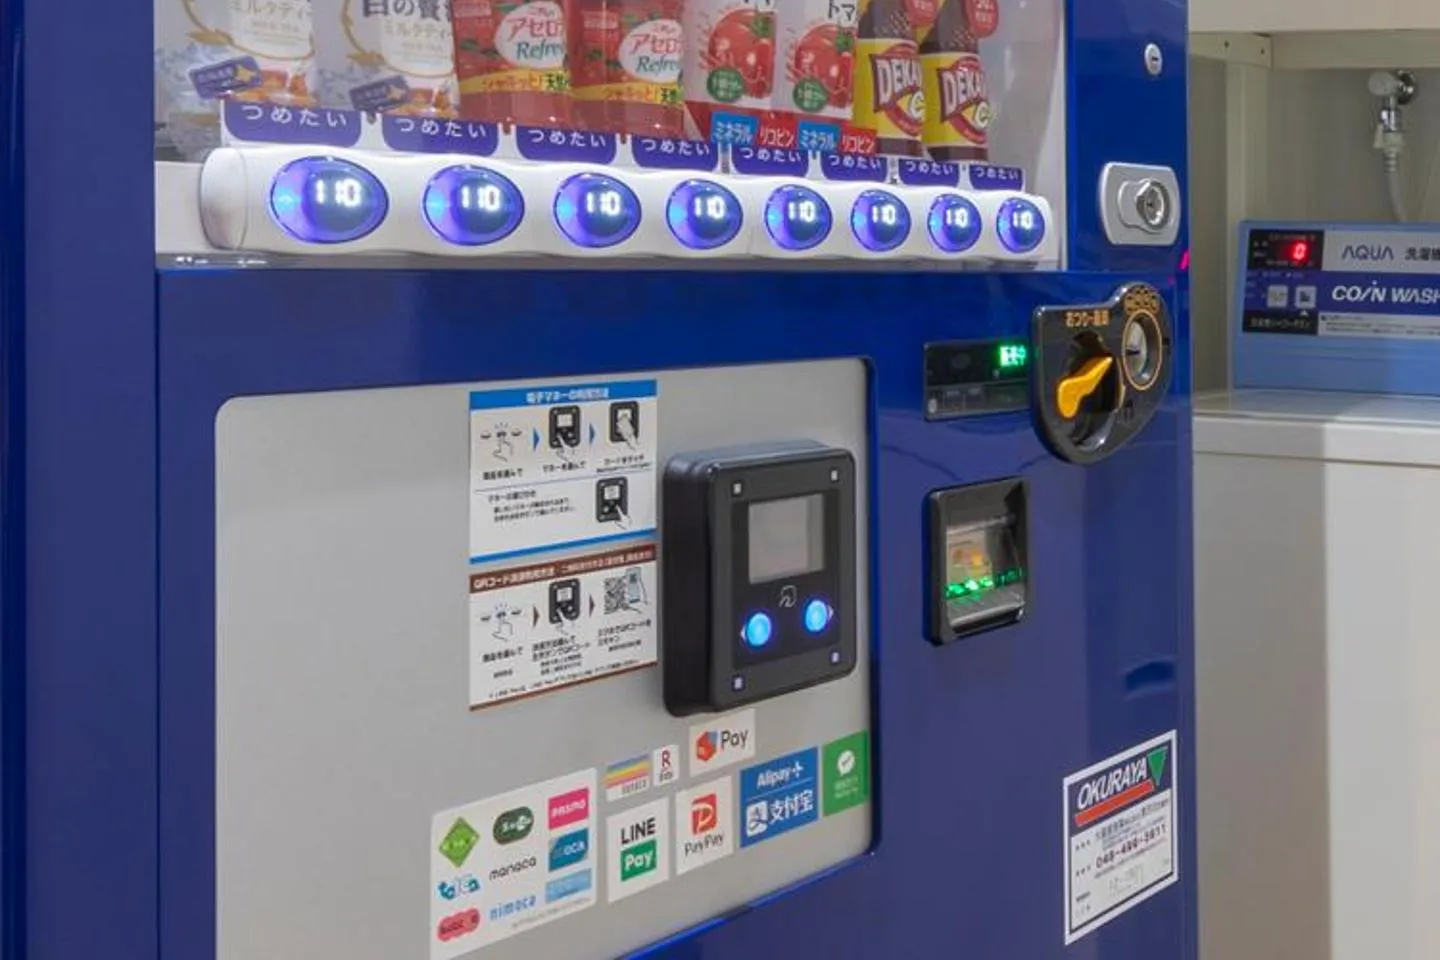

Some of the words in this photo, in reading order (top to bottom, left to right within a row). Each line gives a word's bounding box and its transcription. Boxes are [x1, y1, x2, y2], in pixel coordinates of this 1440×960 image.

[243, 106, 347, 127] つめたい
[400, 119, 487, 138] つめたい
[528, 129, 607, 148] つめたい
[760, 126, 795, 148] リコピン
[642, 138, 710, 157] つめたい
[741, 147, 801, 164] つめたい
[842, 135, 876, 154] リコピン
[829, 154, 882, 170] つめたい
[905, 160, 956, 176] つめたい
[314, 179, 361, 207] 110
[461, 185, 500, 211] 110
[585, 191, 621, 215] 110
[694, 194, 726, 219] 110
[788, 200, 816, 222] 110
[872, 203, 896, 225] 110
[945, 207, 970, 228] 110
[1012, 211, 1033, 230] 110
[1292, 242, 1306, 260] 0
[1341, 244, 1395, 261] AQUA
[720, 729, 750, 752] Pay
[1076, 756, 1149, 811] OKURAYA
[769, 790, 814, 825] 支付宝
[619, 817, 657, 845] LINE
[683, 832, 725, 857] PayPay
[623, 850, 654, 872] Pay
[488, 895, 537, 922] nimoca
